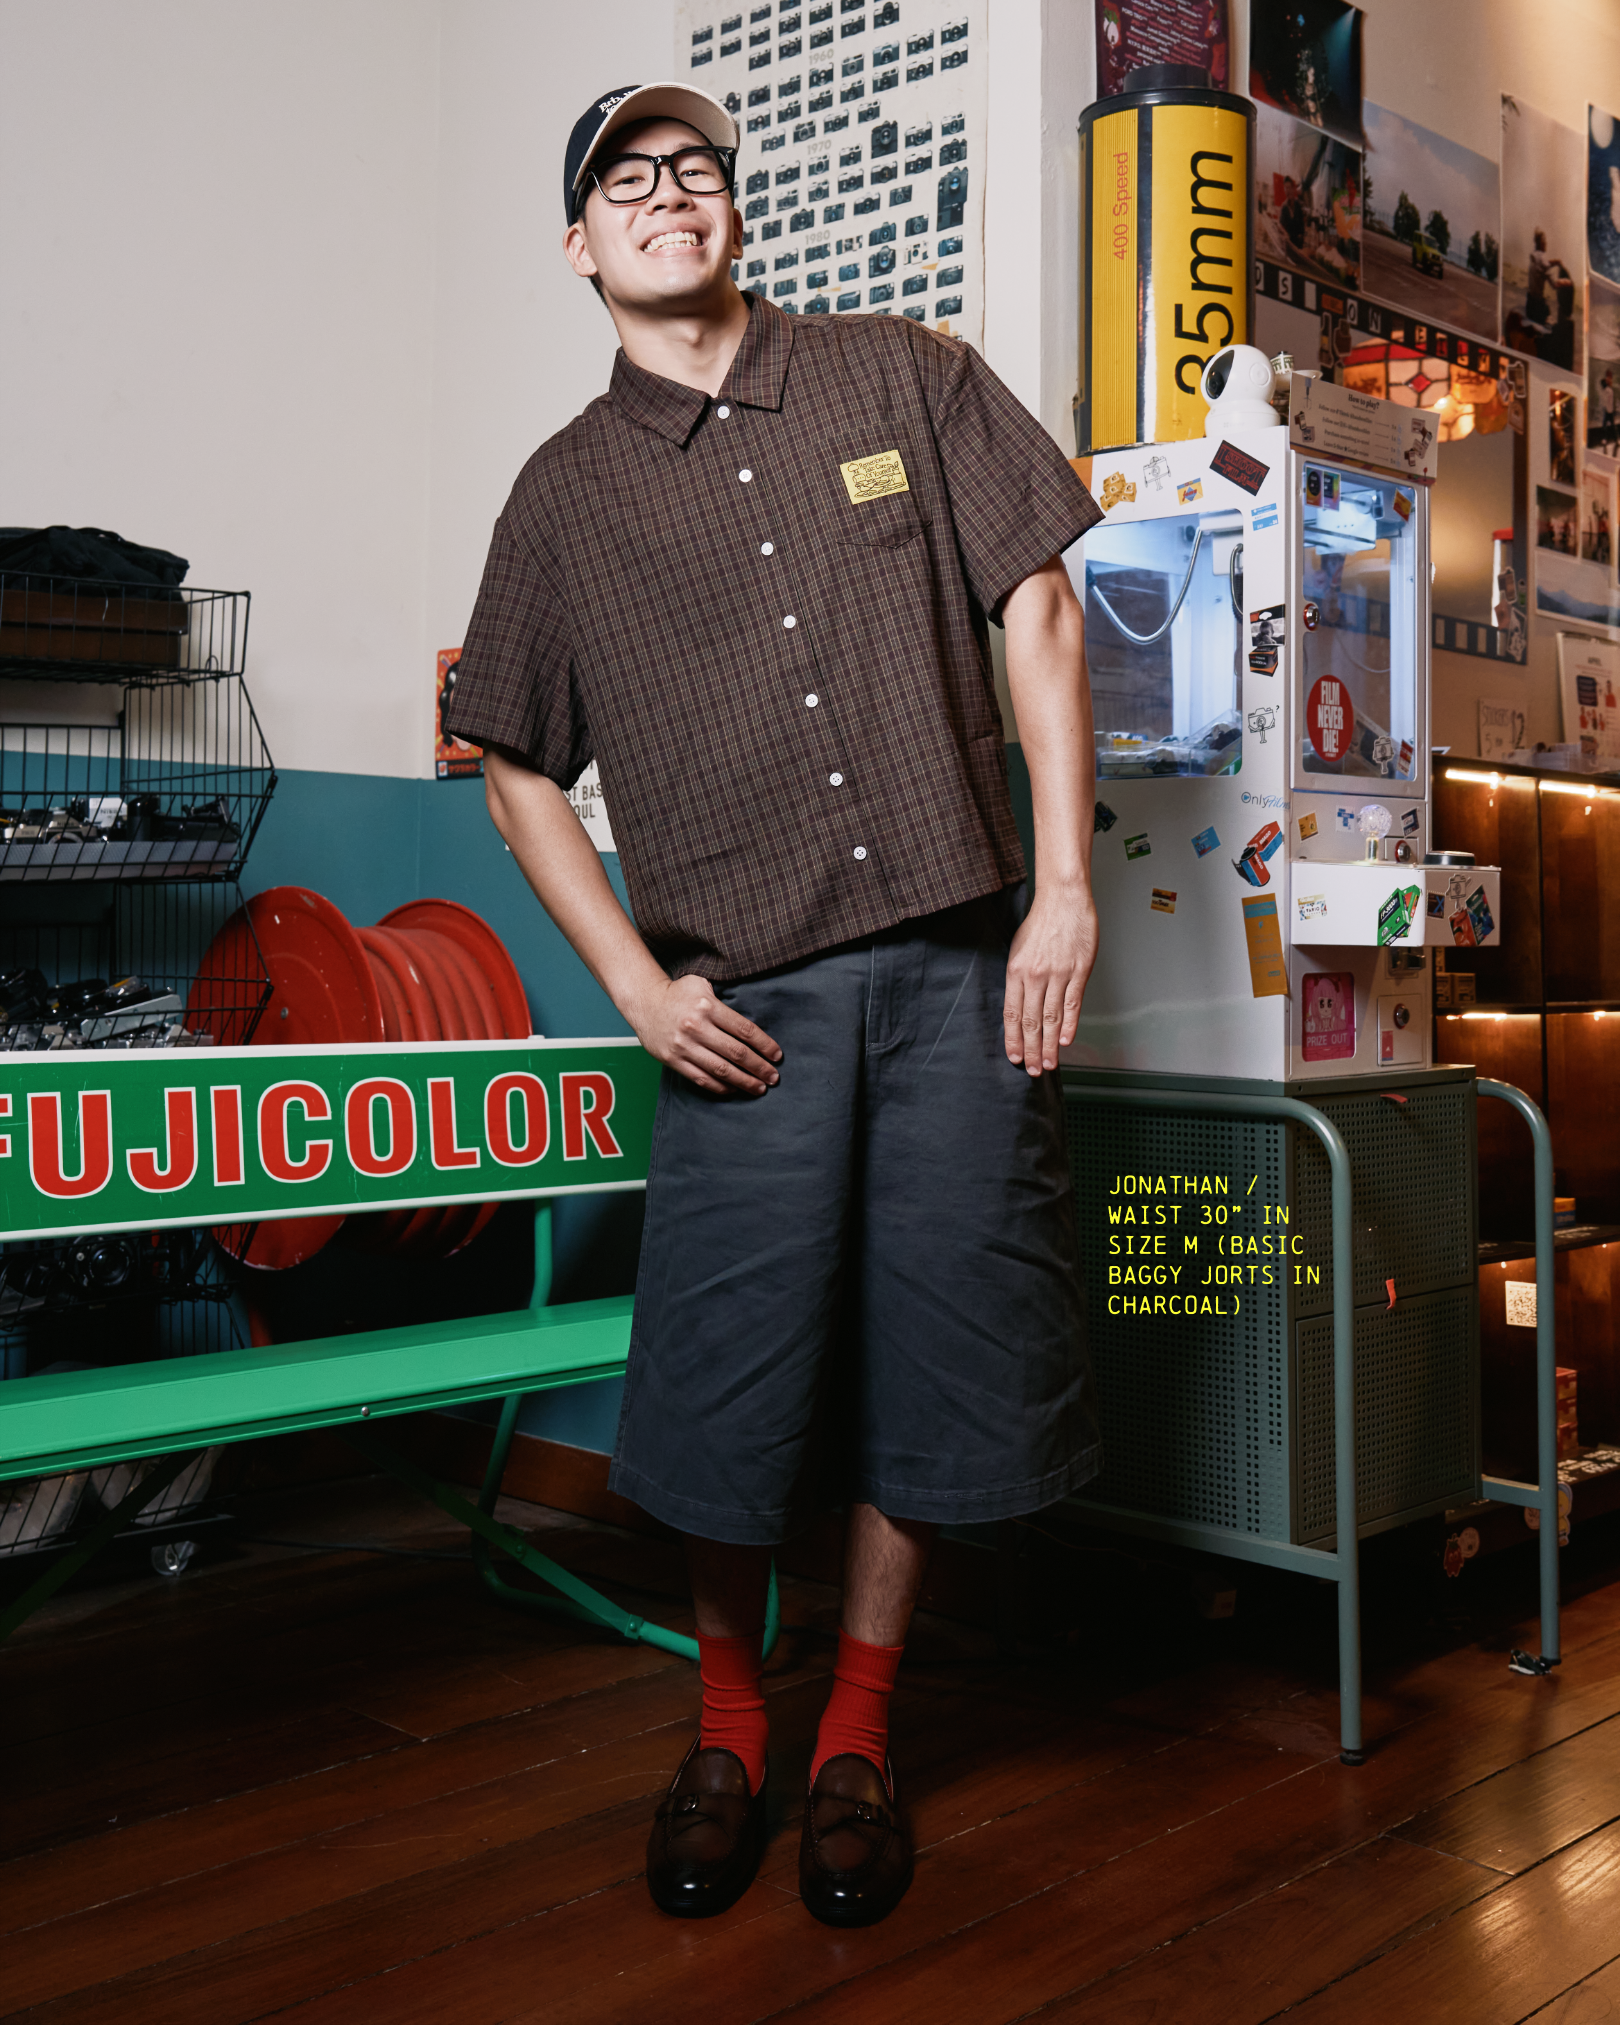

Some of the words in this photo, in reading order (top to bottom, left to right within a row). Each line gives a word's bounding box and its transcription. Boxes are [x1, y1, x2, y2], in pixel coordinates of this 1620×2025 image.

[808, 49, 834, 65] 1960
[807, 139, 832, 156] 1970
[1113, 152, 1131, 216] Speed
[805, 230, 831, 245] 1980
[1113, 224, 1128, 260] 400
[1321, 680, 1340, 706] FILM
[1317, 704, 1344, 730] NEVER
[1322, 729, 1339, 753] DIE!
[1306, 1034, 1328, 1047] PRIZE
[1331, 1032, 1348, 1045] OUT
[0, 1071, 624, 1199] UJICOLOR
